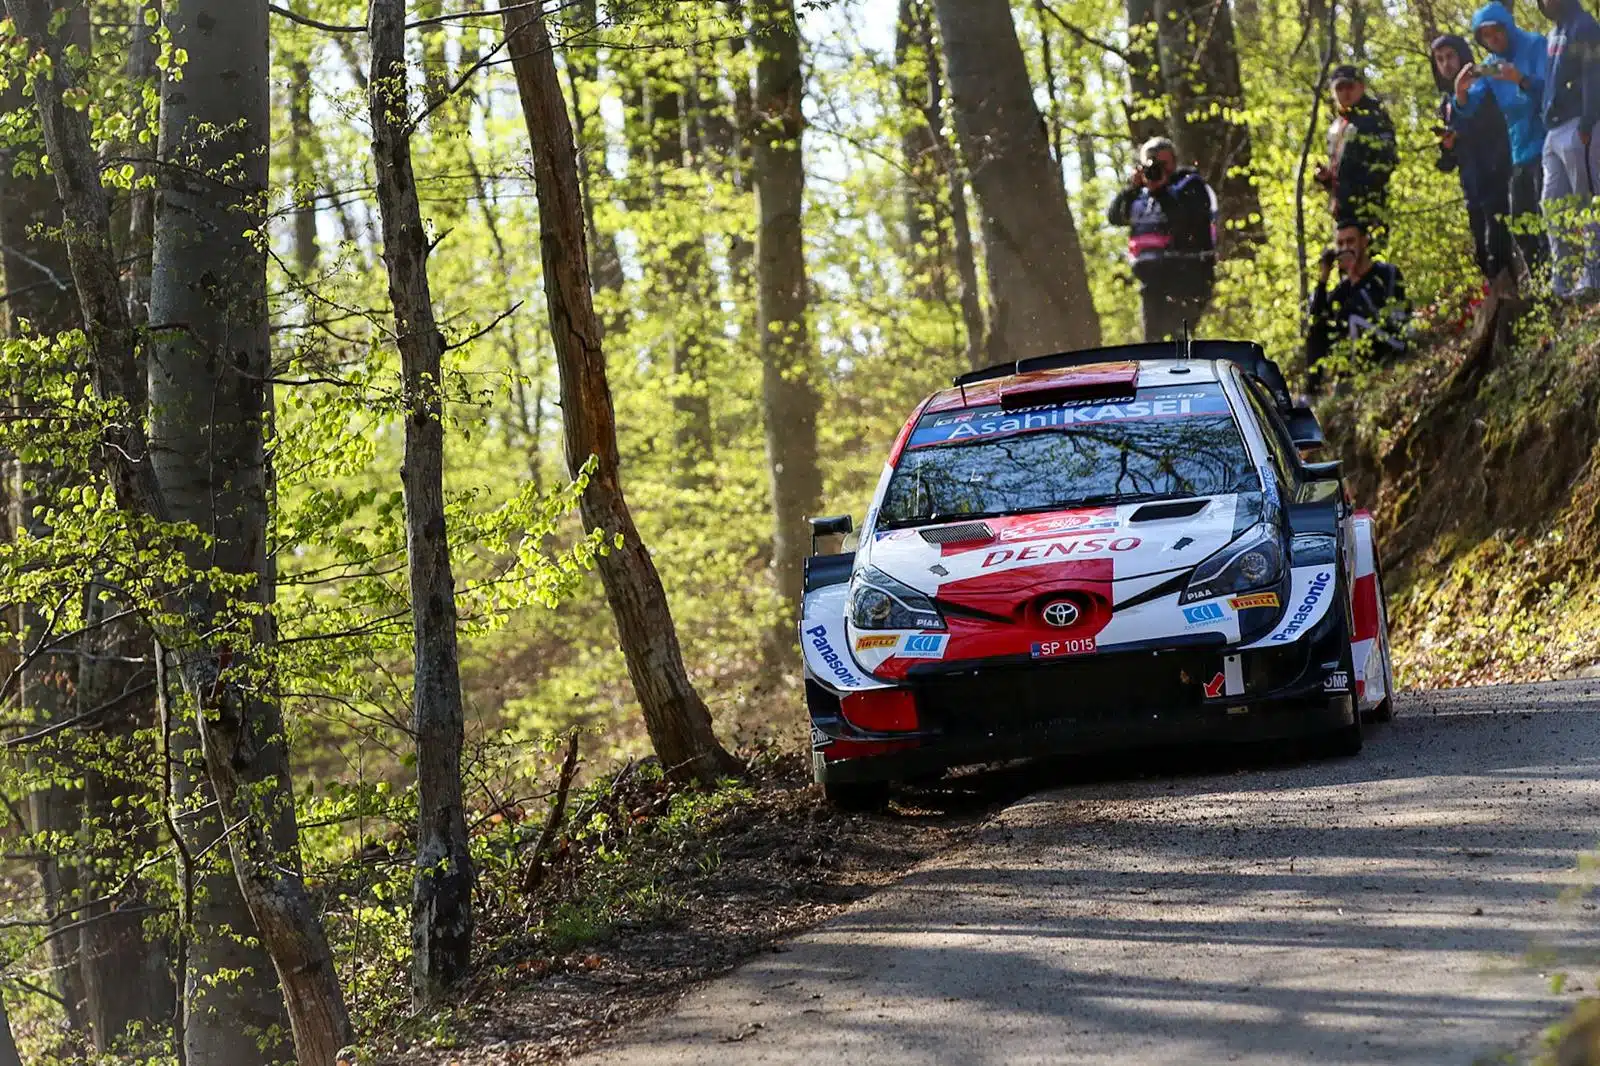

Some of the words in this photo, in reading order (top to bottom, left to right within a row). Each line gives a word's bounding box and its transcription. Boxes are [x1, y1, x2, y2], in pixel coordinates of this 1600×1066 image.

[979, 404, 1056, 419] TOYOTA
[1062, 396, 1135, 407] GAZOO
[981, 536, 1142, 568] DENSO
[1187, 588, 1212, 600] PIAA
[1231, 594, 1277, 609] PIRELLI
[1271, 572, 1331, 640] Panasonic
[916, 618, 940, 627] PIAA
[1041, 641, 1060, 655] SP
[1064, 638, 1094, 652] 1015
[806, 624, 861, 687] Panasonic
[1323, 674, 1348, 688] OMP
